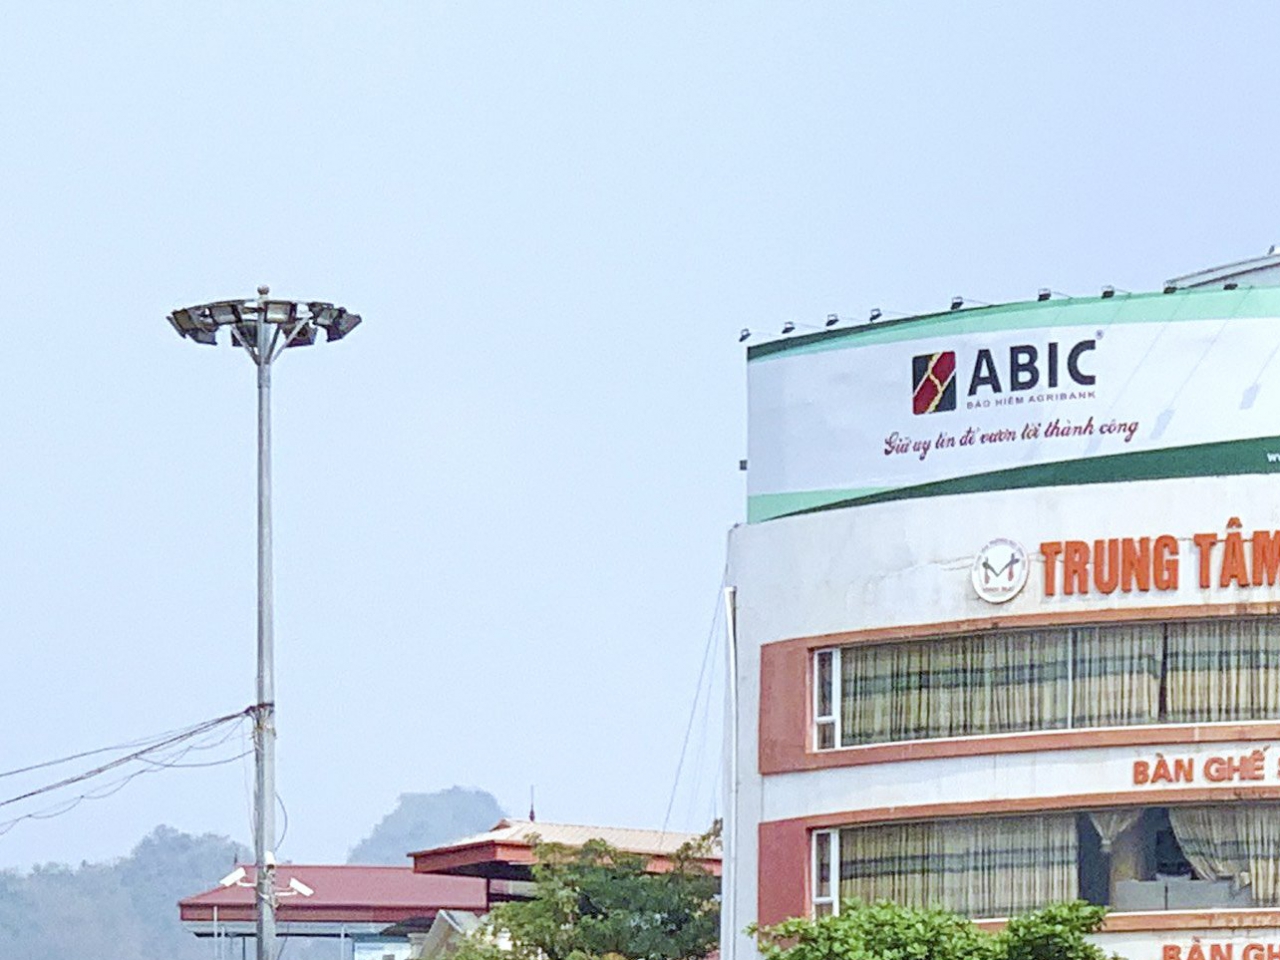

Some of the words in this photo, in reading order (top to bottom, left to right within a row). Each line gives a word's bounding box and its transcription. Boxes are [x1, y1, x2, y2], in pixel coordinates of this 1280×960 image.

[967, 339, 1096, 396] ABIC
[1028, 390, 1096, 402] AGRIBANK
[1044, 416, 1094, 437] thành
[1098, 419, 1139, 443] công
[1039, 534, 1179, 596] TRUNG
[1132, 752, 1195, 785] BÀN
[1203, 745, 1271, 783] GHẾ
